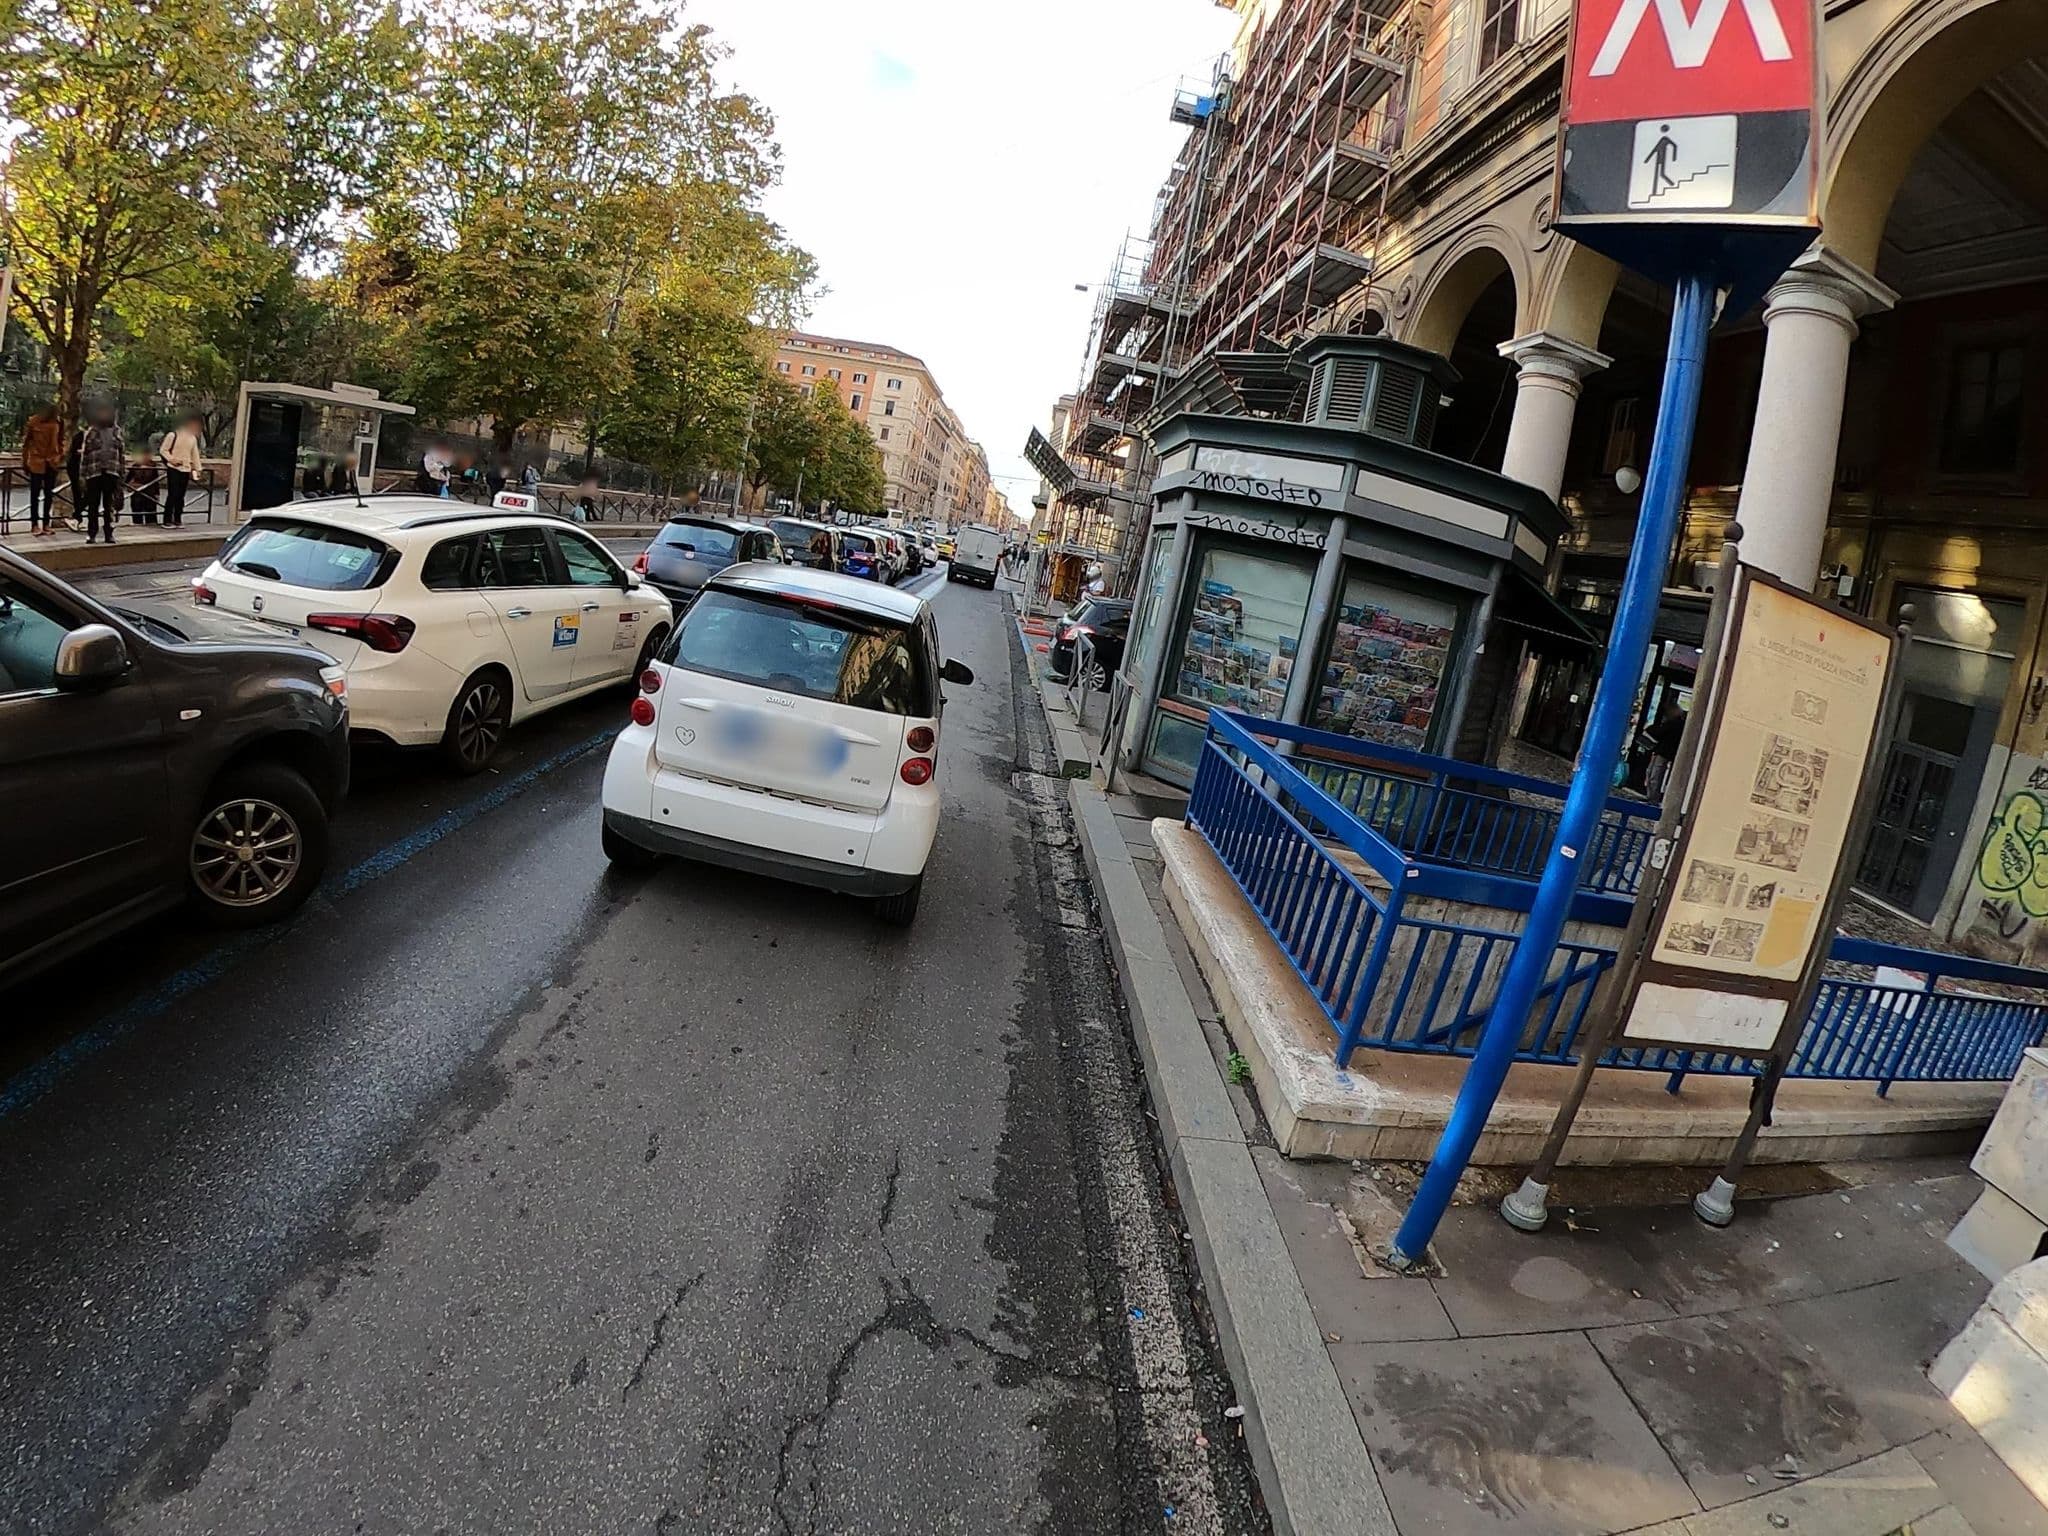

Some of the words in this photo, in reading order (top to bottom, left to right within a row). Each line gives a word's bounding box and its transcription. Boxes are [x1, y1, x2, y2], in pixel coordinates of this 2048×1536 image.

[1588, 0, 1793, 77] M
[501, 496, 528, 507] TAXI
[766, 696, 795, 709] smart
